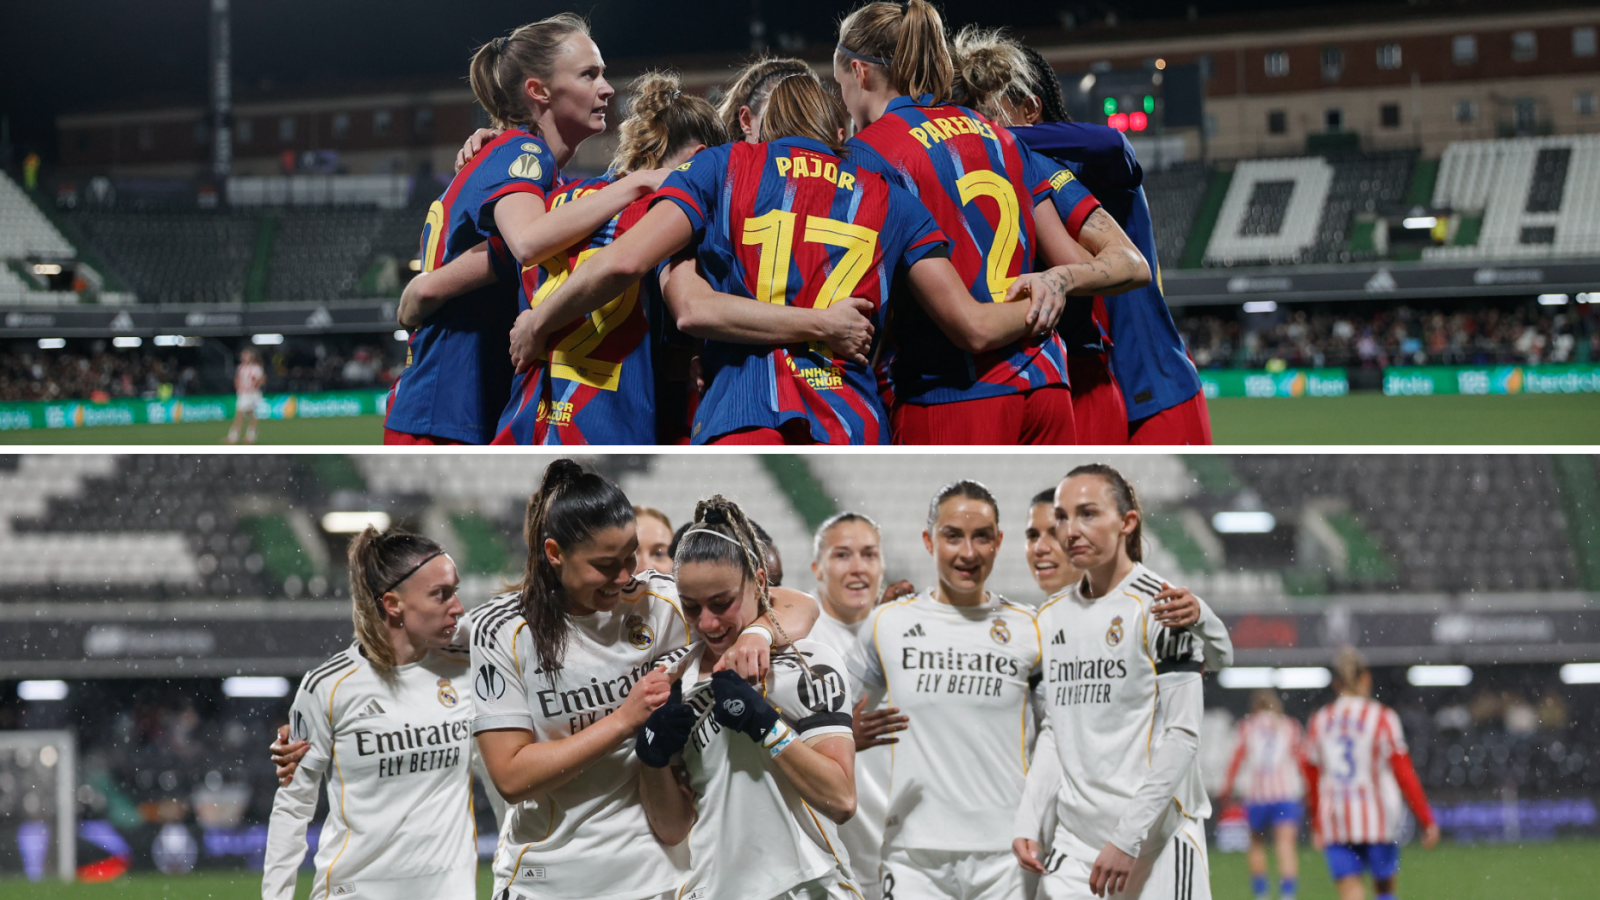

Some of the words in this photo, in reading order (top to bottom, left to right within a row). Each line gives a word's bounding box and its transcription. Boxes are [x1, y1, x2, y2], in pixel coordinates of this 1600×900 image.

[908, 116, 998, 149] PAREDES
[775, 156, 856, 191] PAJOR
[955, 169, 1028, 303] 2
[742, 208, 879, 358] 17
[902, 647, 1018, 677] Emirates
[1049, 655, 1127, 683] Emirates
[536, 659, 654, 718] Emirate
[803, 671, 841, 713] hp
[916, 673, 942, 693] FLY
[947, 674, 1003, 697] BETTER
[1055, 685, 1073, 706] FLY
[355, 720, 468, 756] Emirates
[379, 755, 404, 778] FLY
[409, 747, 460, 773] BETTER
[1335, 735, 1357, 784] 3
